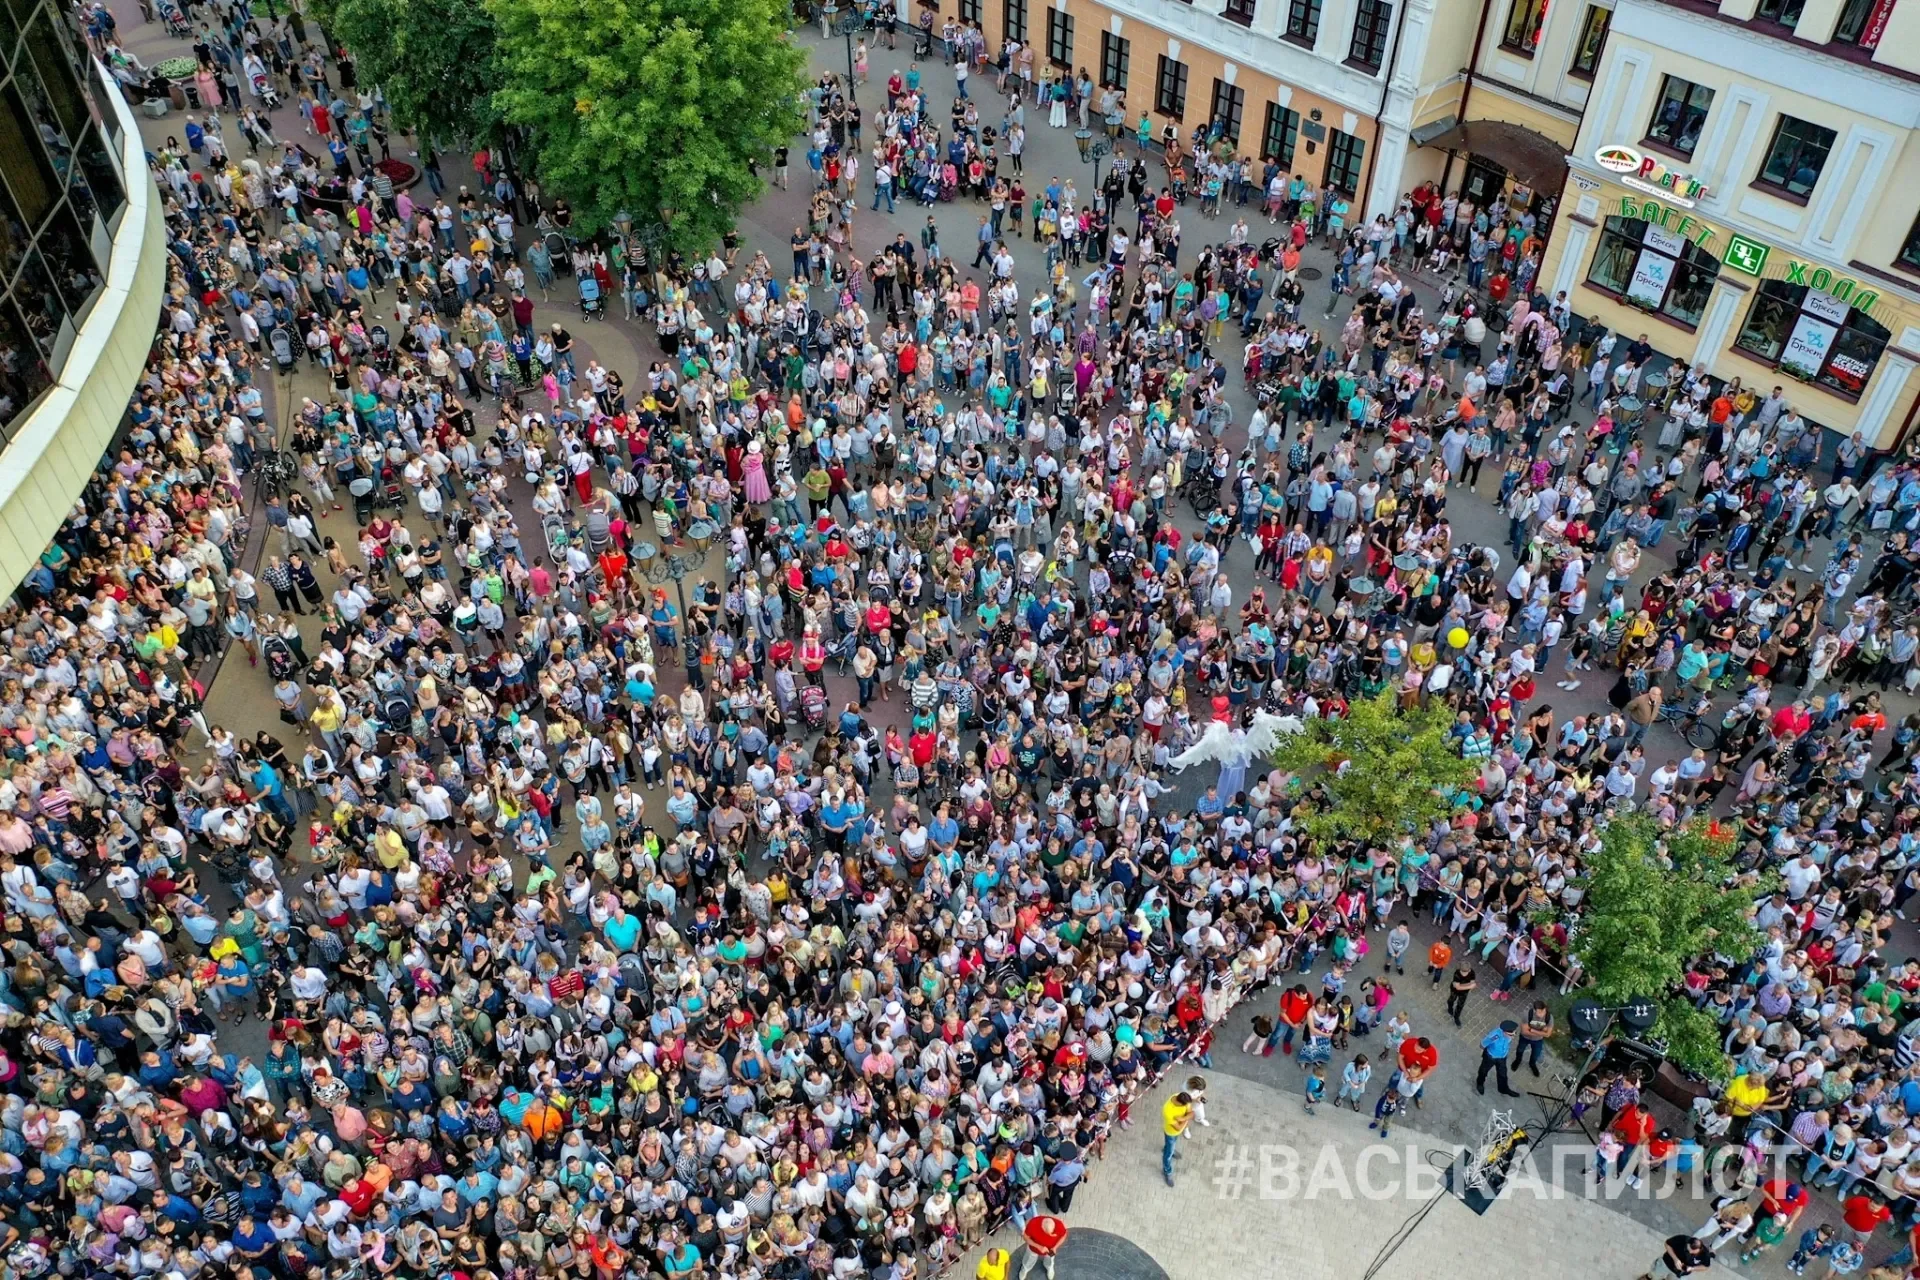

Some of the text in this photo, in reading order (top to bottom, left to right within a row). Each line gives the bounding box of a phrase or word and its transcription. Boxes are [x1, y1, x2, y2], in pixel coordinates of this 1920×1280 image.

[1579, 182, 1589, 190] 67
[1650, 232, 1677, 251] Брест
[1620, 196, 1880, 313] БАГЕТ ХОЛЛ
[1635, 271, 1664, 292] Брест
[1832, 356, 1867, 374] КСЕРО
